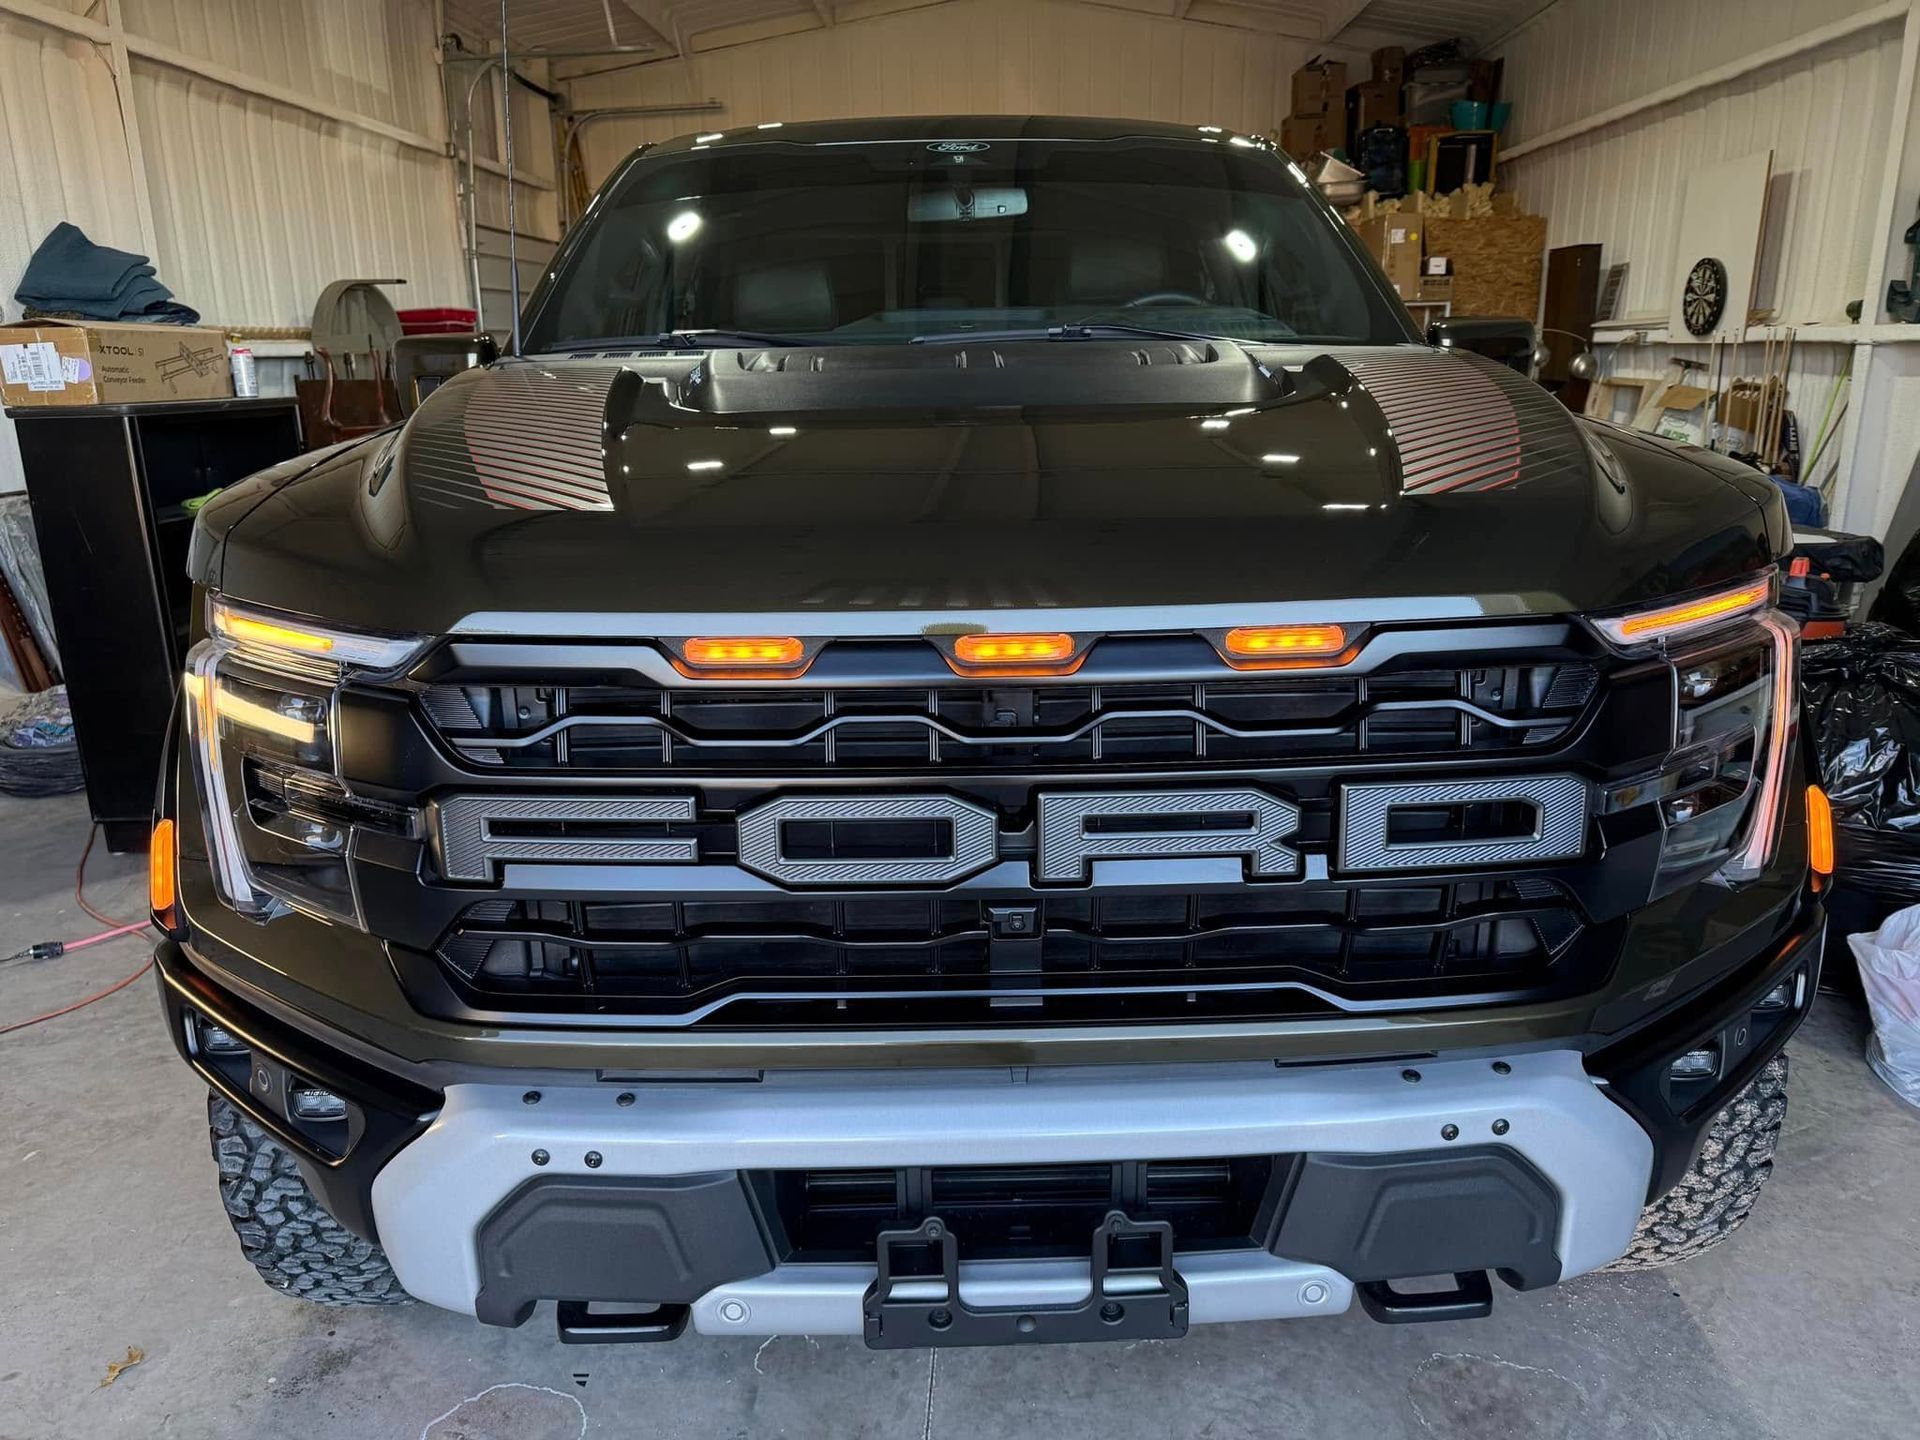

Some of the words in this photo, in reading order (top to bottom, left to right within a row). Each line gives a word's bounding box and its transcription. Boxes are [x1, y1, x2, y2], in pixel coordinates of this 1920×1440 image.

[99, 345, 134, 356] XTOOL
[102, 365, 130, 373] Automatic
[103, 376, 127, 385] Conveyor
[437, 775, 1589, 885] FORD
